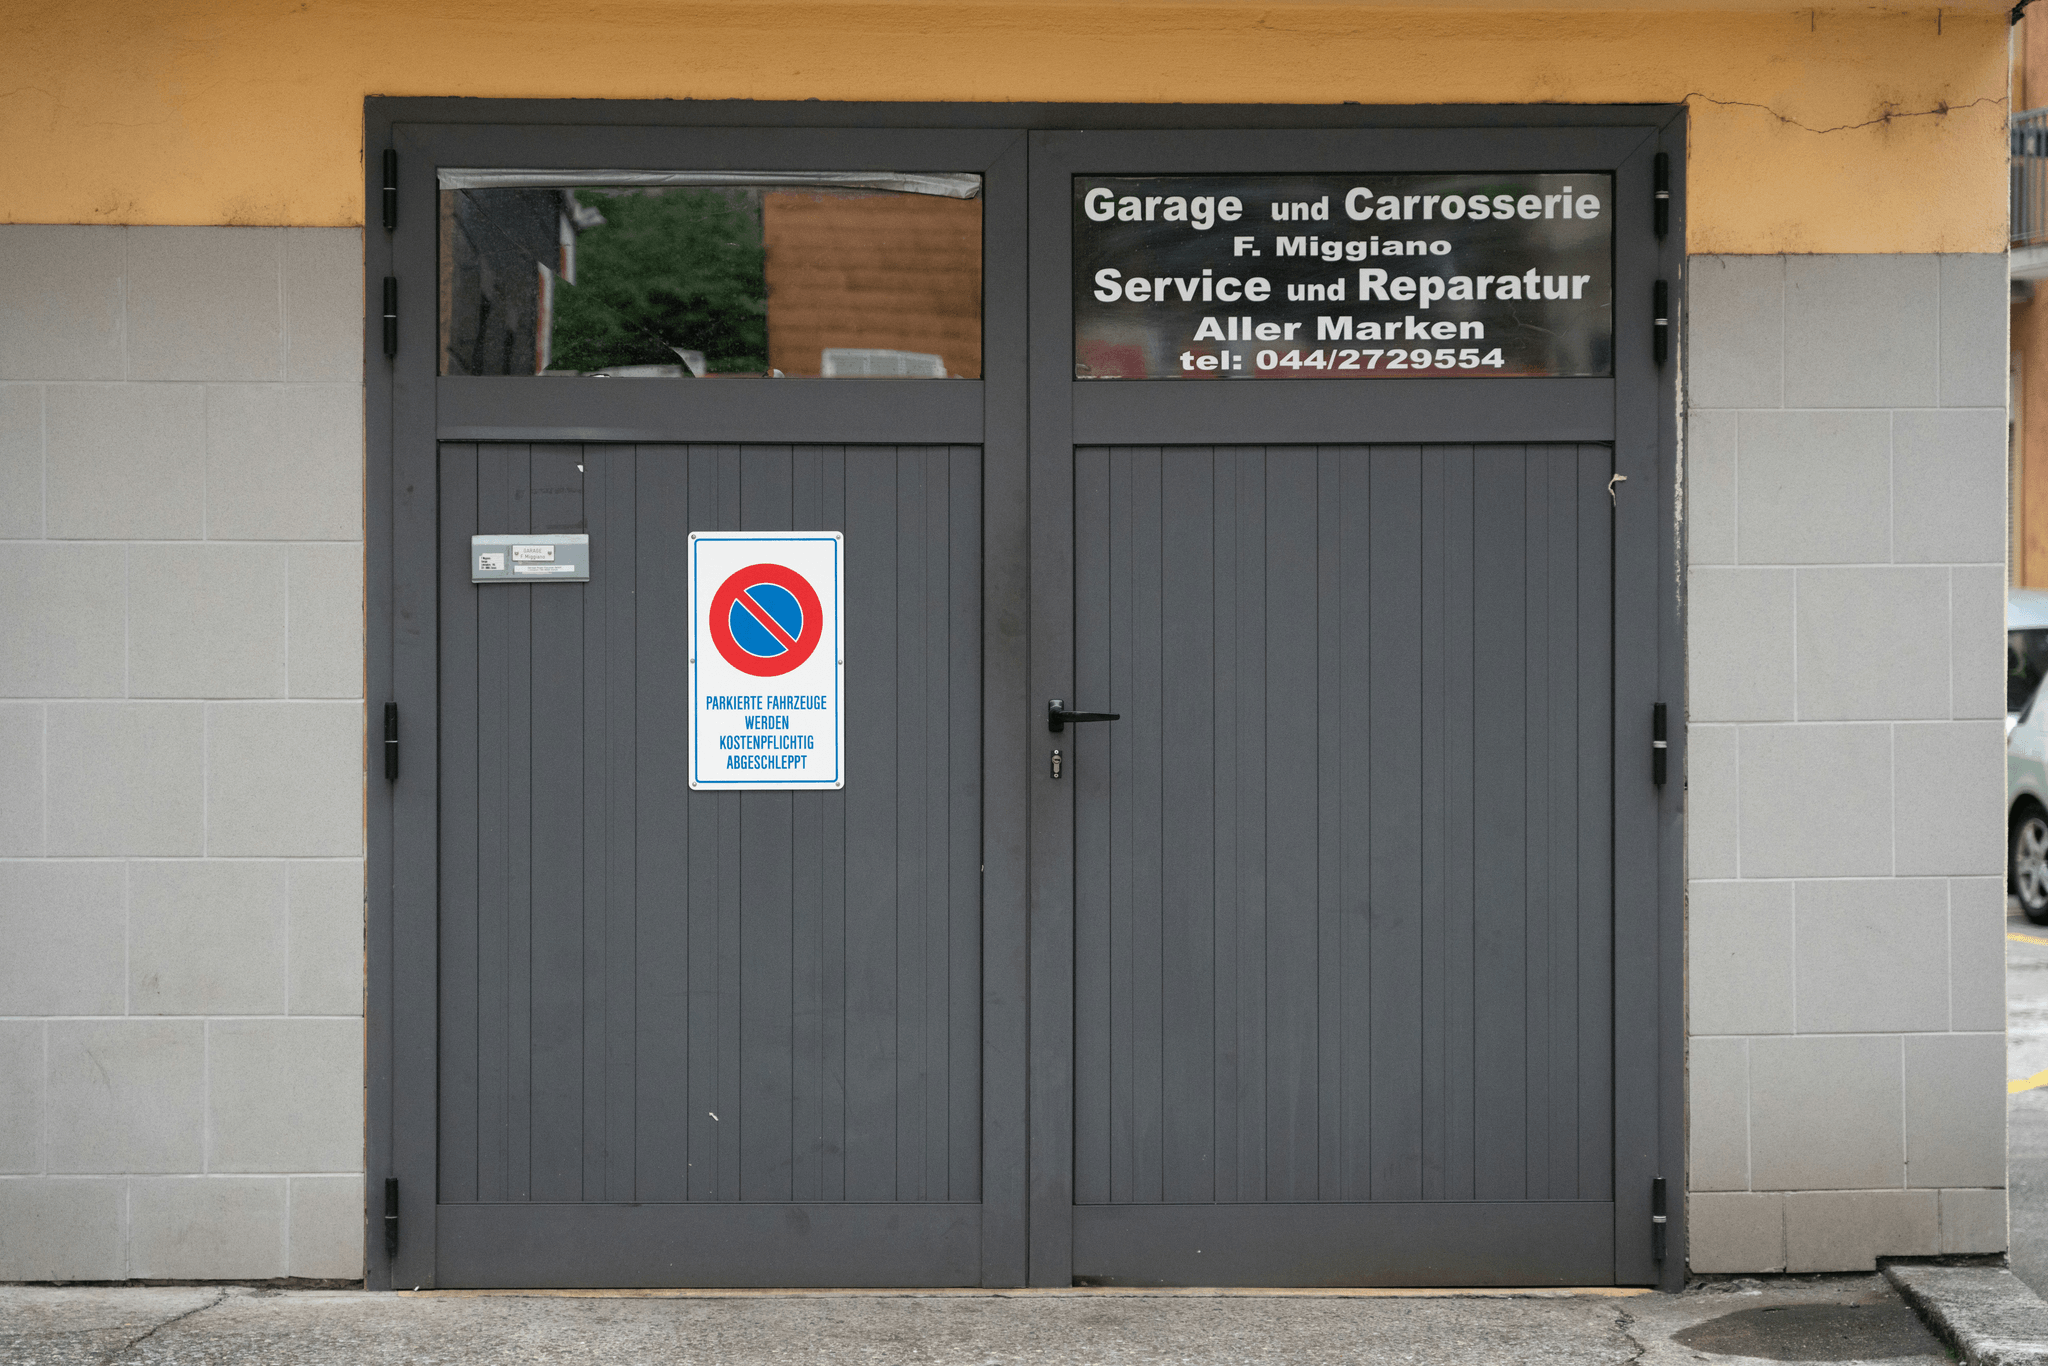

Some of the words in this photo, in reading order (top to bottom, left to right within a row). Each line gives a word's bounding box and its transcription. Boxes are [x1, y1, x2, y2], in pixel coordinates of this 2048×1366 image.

[1084, 187, 1243, 230] Garage
[1271, 195, 1329, 221] und
[1345, 186, 1601, 221] Carrosserie
[1234, 236, 1261, 257] F.
[1276, 235, 1452, 262] Miggiano
[1093, 268, 1271, 303] Service
[1287, 277, 1345, 302] und
[1359, 267, 1591, 309] Reparatur
[1192, 316, 1303, 342] Aller
[1317, 315, 1485, 341] Marken
[1179, 350, 1242, 371] tel:
[1255, 347, 1505, 371] 044/2729554
[706, 695, 763, 711] PARKIERTE
[766, 695, 827, 710] FAHRZEUGE
[744, 715, 790, 730] WERDEN
[719, 735, 814, 750] KOSTENPFLICHTIG
[726, 754, 808, 770] ABGESCHLEPPT
